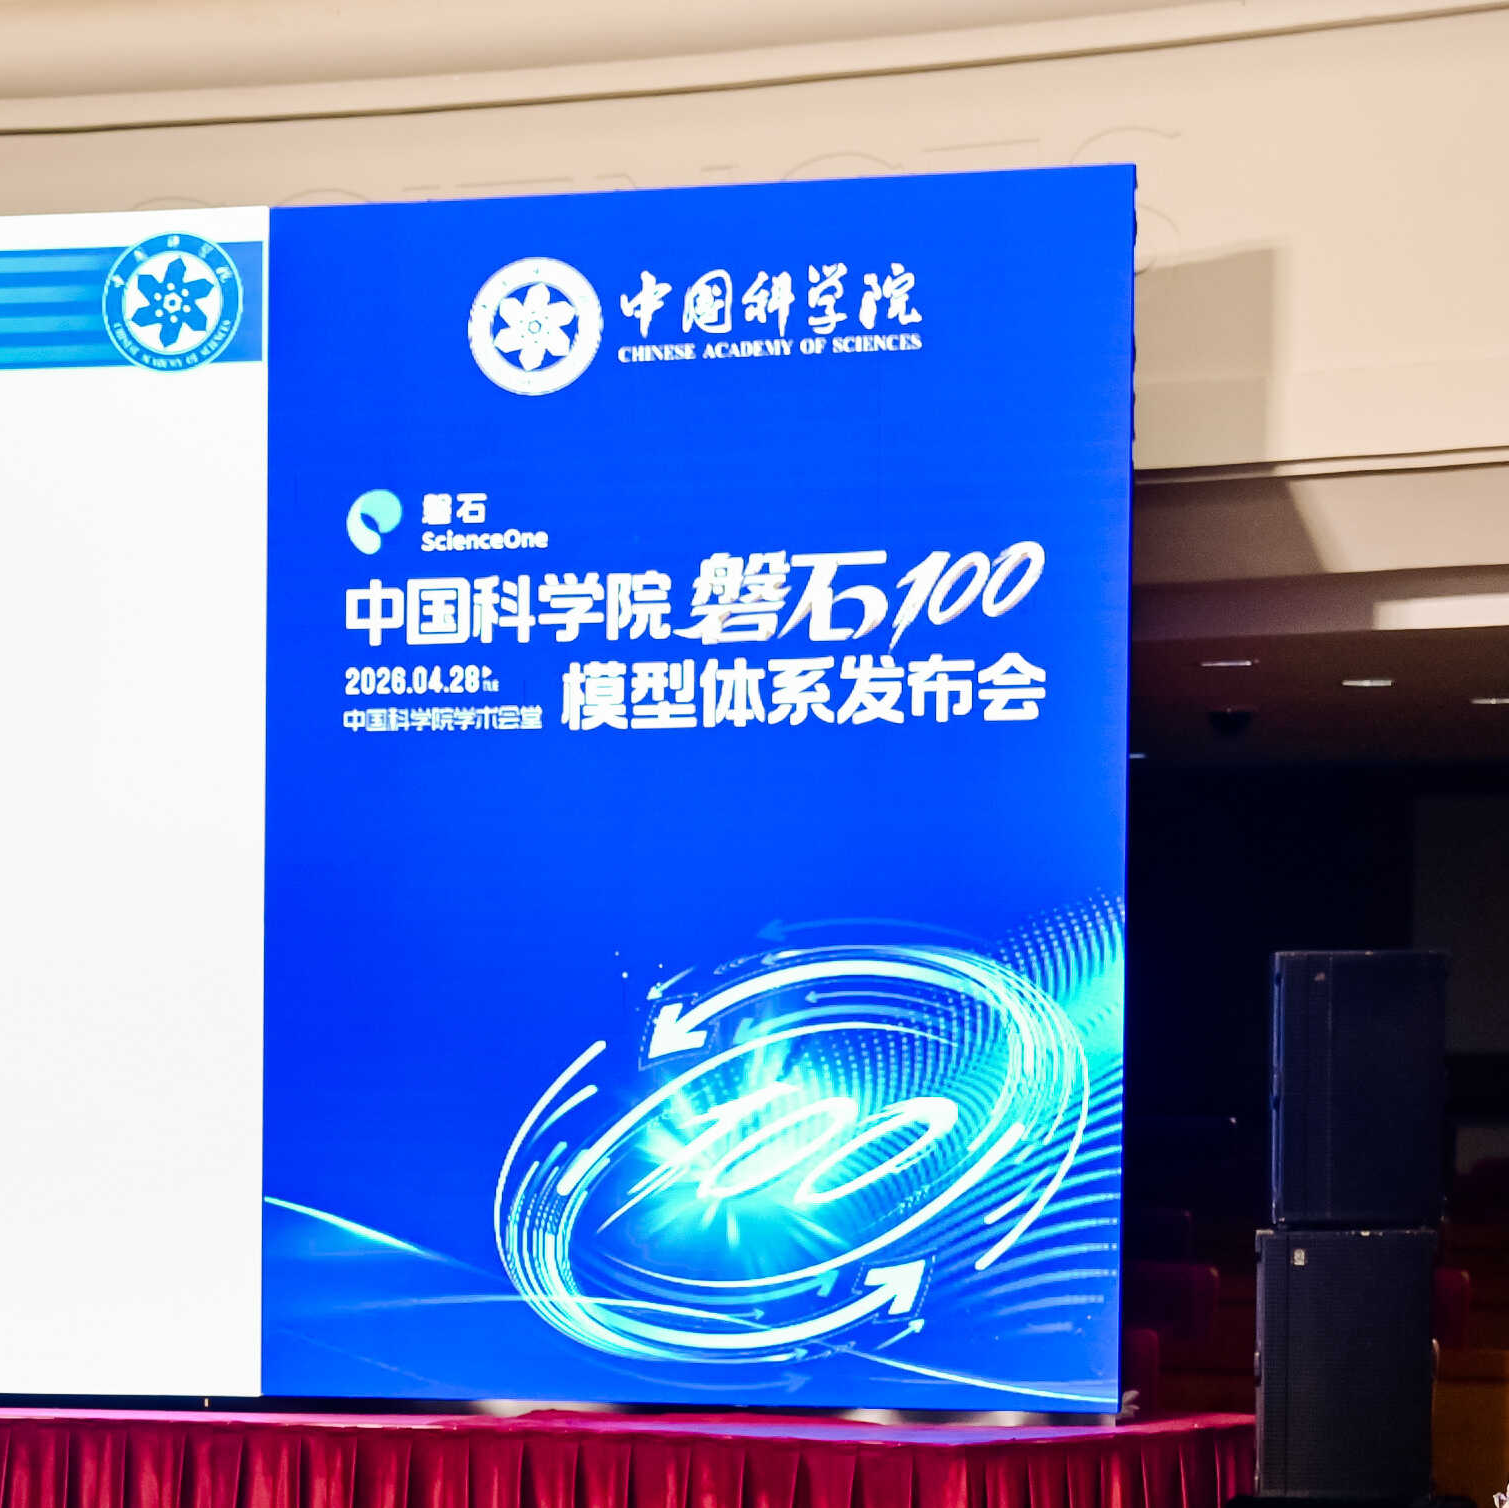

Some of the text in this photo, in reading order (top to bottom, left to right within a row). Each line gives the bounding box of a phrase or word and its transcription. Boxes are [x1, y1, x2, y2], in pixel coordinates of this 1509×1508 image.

[618, 333, 923, 363] CHINESE ACADEMY OF SCIENCES
[421, 529, 549, 552] ScienceOne
[345, 665, 480, 696] 2026.04.28
[559, 652, 1047, 732] 模型体系发布会
[343, 705, 543, 732] 中国科学院学术会堂
